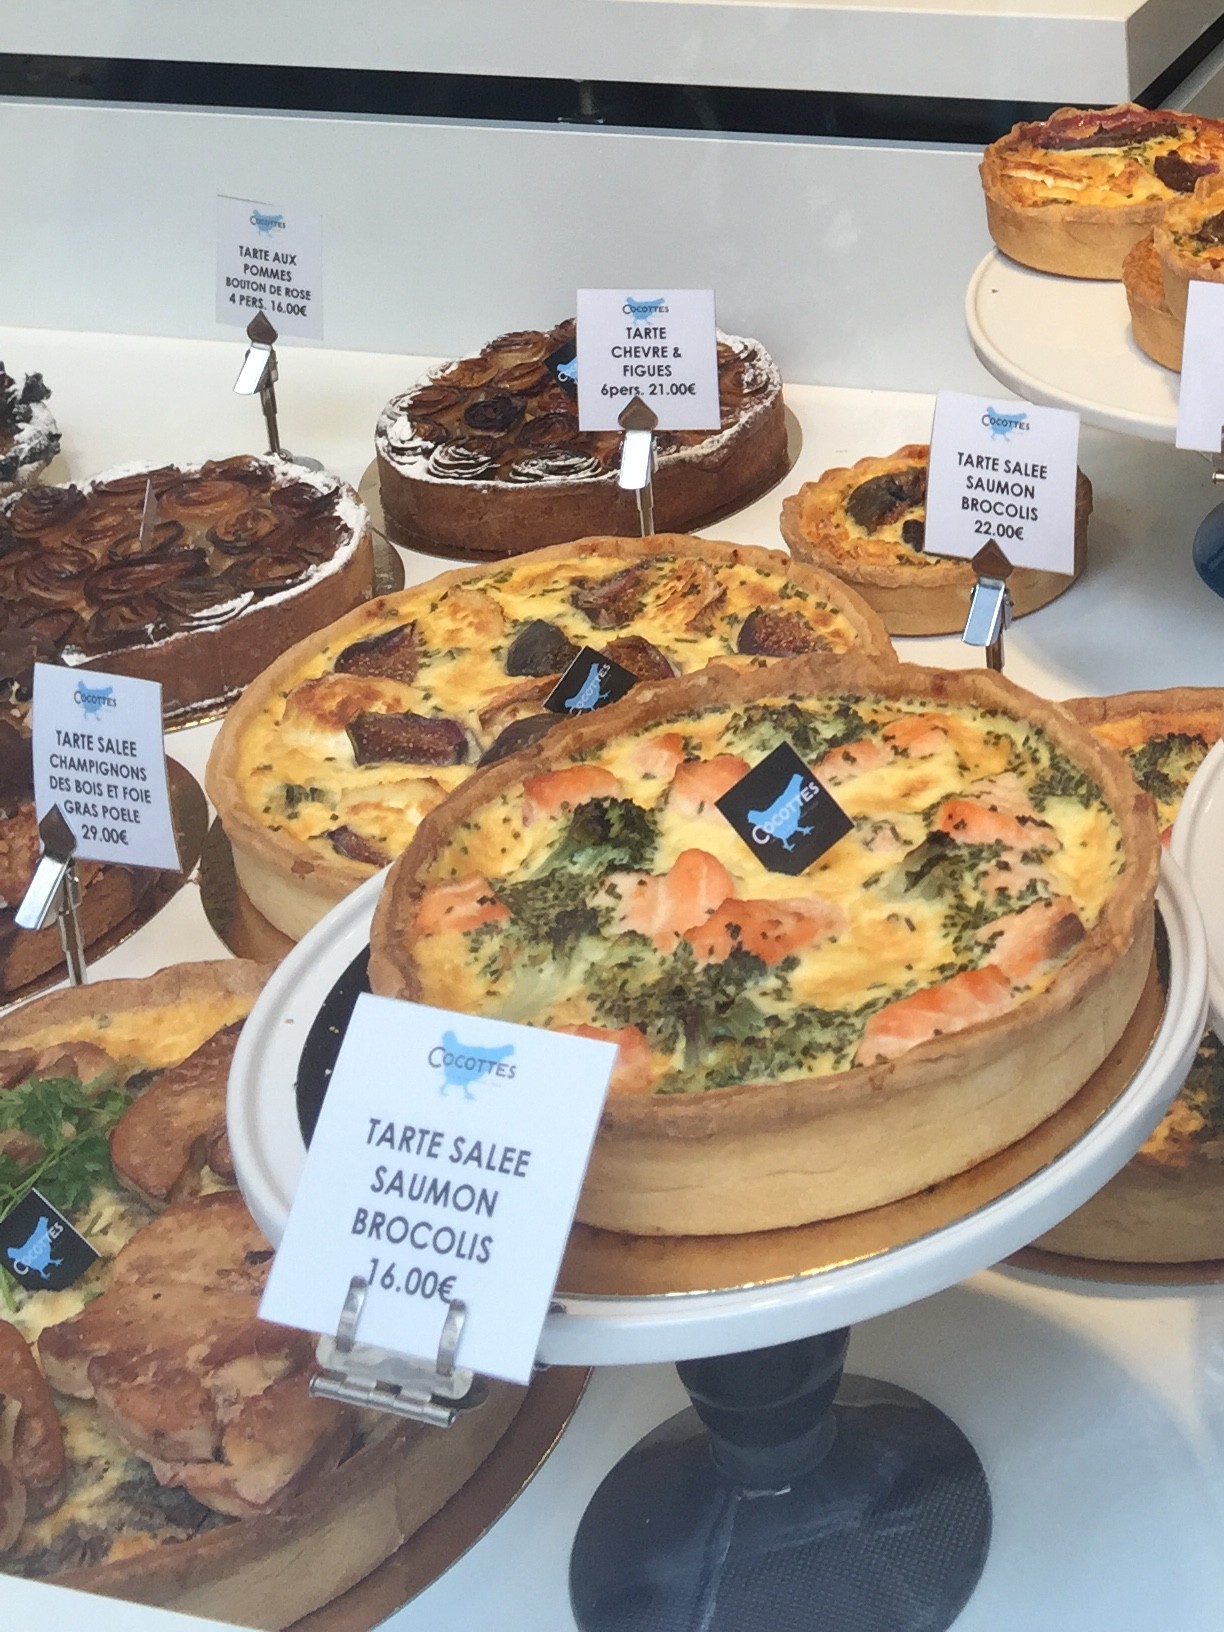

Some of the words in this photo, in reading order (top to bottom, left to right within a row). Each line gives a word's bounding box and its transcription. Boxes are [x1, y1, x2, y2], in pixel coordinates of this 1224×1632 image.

[239, 245, 270, 262] TARTE
[273, 254, 297, 266] AUX
[243, 263, 292, 282] POMMES
[226, 276, 267, 294] BOUTON
[269, 284, 282, 297] DE
[285, 287, 312, 301] ROSE
[229, 293, 236, 305] 4
[239, 295, 267, 311] PERS.
[270, 300, 307, 317] 16.00€
[626, 327, 667, 340] TARTE
[611, 346, 668, 359] CHEVRE
[672, 347, 682, 359] &
[623, 365, 672, 378] FIGUES
[601, 383, 644, 398] 6pers.
[649, 383, 697, 396] 21.00€
[957, 452, 1000, 472] TARTE
[1004, 459, 1048, 480] SALEE
[966, 475, 1035, 500] SAUMON
[961, 496, 1039, 521] BROCOLIS
[974, 520, 1024, 540] 22.00€
[56, 730, 93, 751] TARTE
[97, 737, 137, 758] SALEE
[50, 753, 147, 782] CHAMPIGNONS
[50, 776, 71, 792] DES
[75, 779, 103, 797] BOIS
[107, 785, 119, 799] ET
[123, 787, 151, 804] FOIE
[64, 800, 98, 818] GRAS
[102, 806, 141, 824] POELE
[81, 824, 129, 846] 29.00€
[366, 1118, 444, 1160] TARTE
[448, 1136, 532, 1178] SALEE
[370, 1165, 499, 1218] SAUMON
[351, 1207, 493, 1264] BROCOLIS
[367, 1258, 457, 1304] 16.00€
